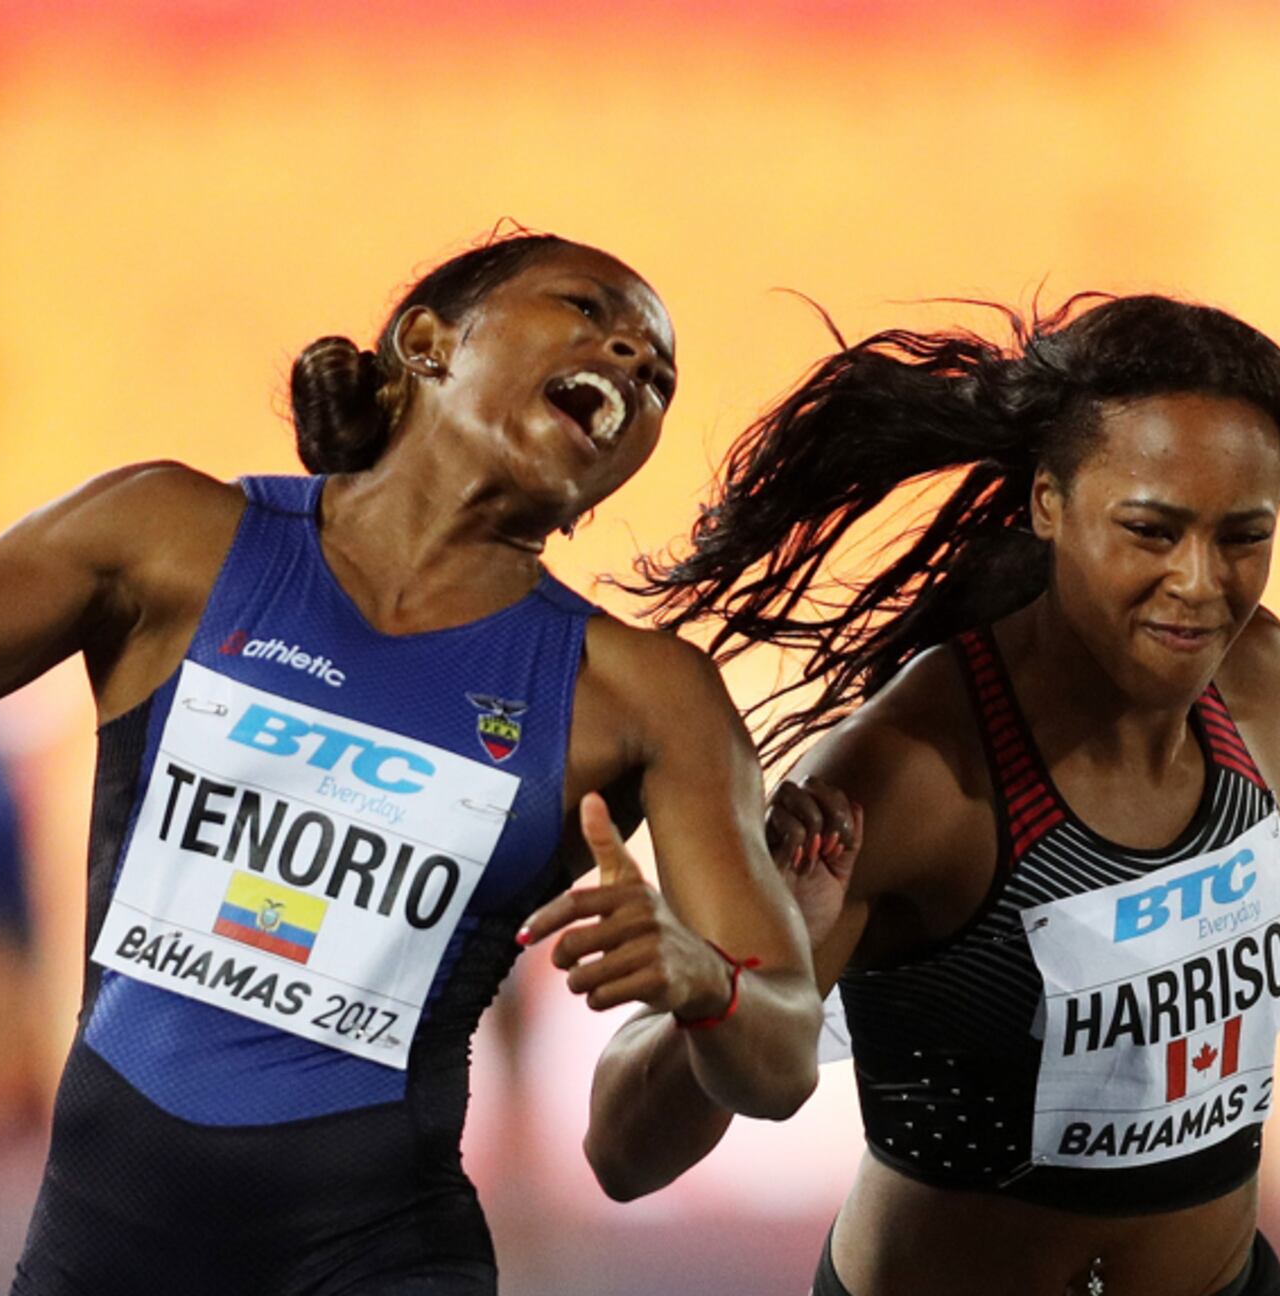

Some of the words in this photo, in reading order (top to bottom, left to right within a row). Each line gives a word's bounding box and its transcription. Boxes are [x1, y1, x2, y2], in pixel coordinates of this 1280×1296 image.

[242, 638, 347, 688] athletic
[227, 703, 437, 796] BTC
[158, 762, 462, 931] TENORIO
[1112, 847, 1258, 944] BTC
[115, 925, 313, 1016] BAHAMAS
[310, 994, 400, 1045] 2017
[1056, 1082, 1249, 1158] BAHAMAS
